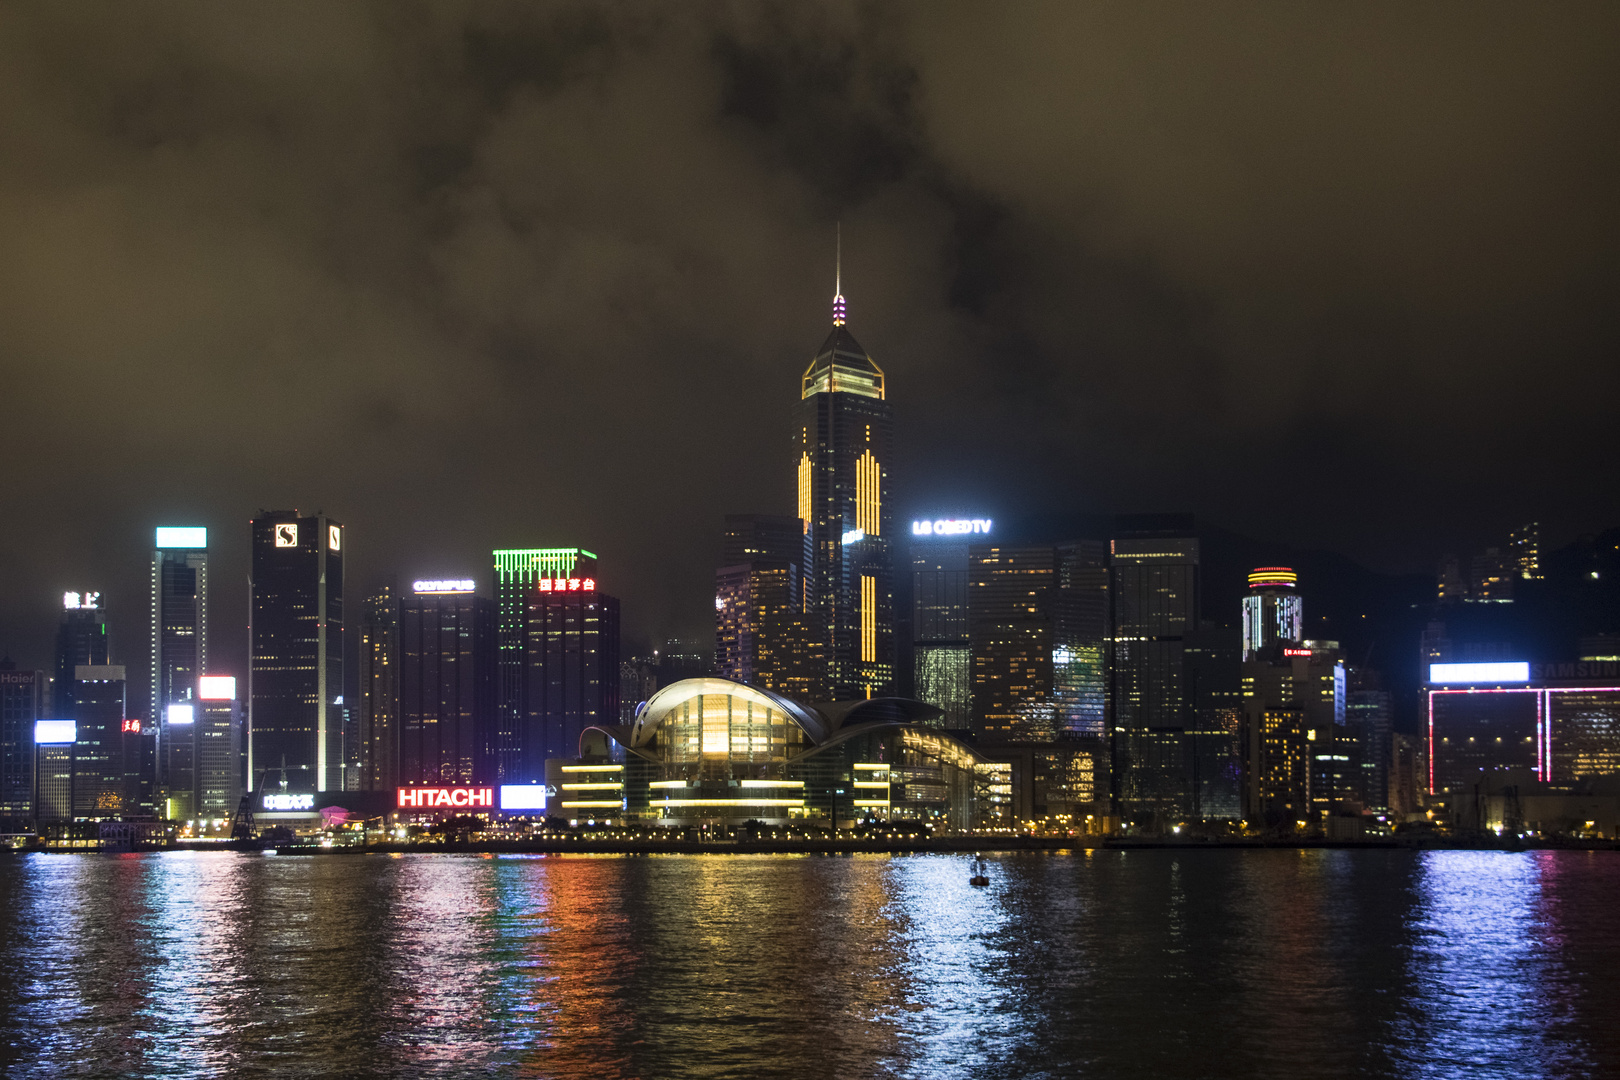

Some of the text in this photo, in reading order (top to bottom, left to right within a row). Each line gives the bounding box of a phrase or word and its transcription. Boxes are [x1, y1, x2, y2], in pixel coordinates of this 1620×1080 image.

[1, 673, 34, 684] Haier
[1531, 661, 1620, 679] SAMSUN
[263, 794, 314, 810] 中太平
[399, 788, 493, 807] HITACHI
